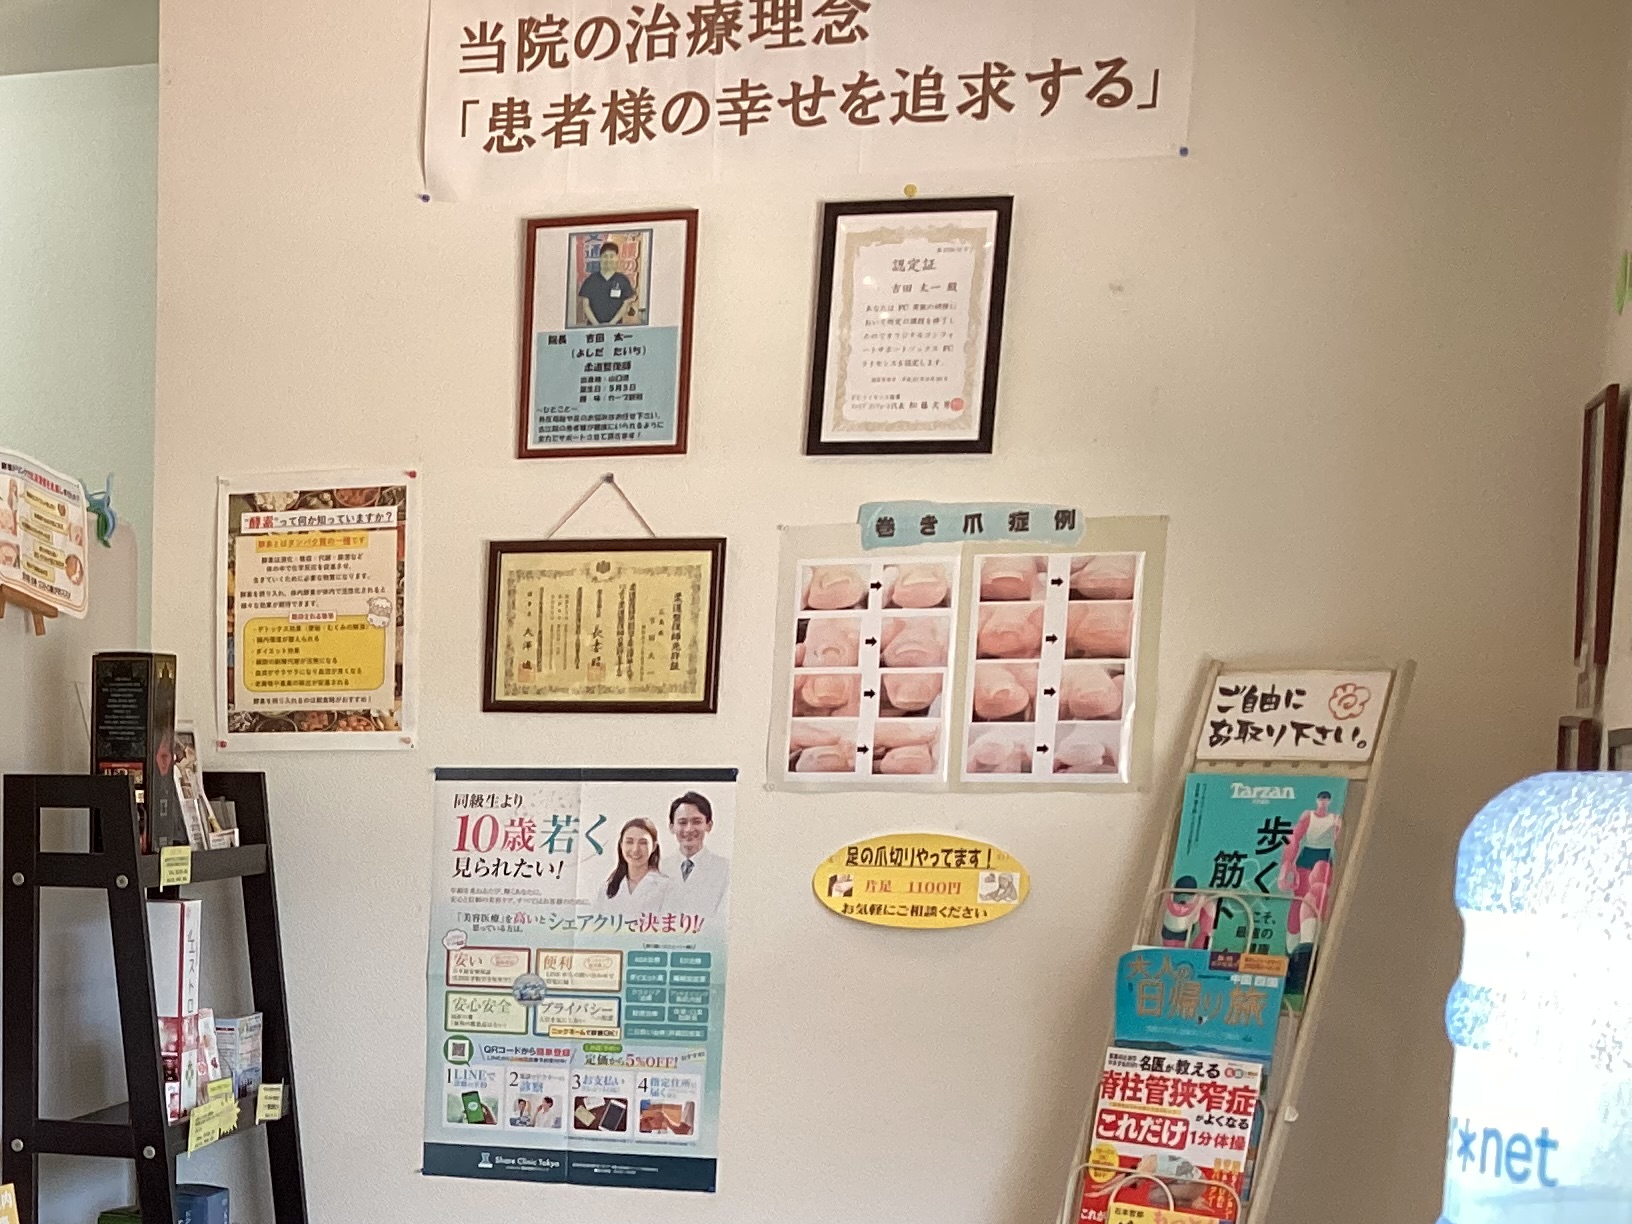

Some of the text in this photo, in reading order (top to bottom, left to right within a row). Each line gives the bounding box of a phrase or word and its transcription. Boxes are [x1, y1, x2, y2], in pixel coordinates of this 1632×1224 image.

[457, 0, 872, 75] 当院の治療理念
[458, 56, 1165, 156] 「患者様の幸せを追求する」
[892, 258, 936, 272] 認定証
[875, 509, 1077, 538] 巻き爪症例
[1217, 684, 1307, 714] ご自由に
[453, 793, 523, 809] 同級生より
[1231, 782, 1296, 800] Tarzan
[452, 813, 608, 856] 10歳若く
[846, 846, 991, 868] 足の爪切りやってます!
[1254, 816, 1294, 896] 歩く
[452, 857, 564, 880] 見られたい!
[865, 880, 961, 895] 片足 1100円
[842, 903, 988, 918] お気軽にご相談ください
[1204, 850, 1249, 950] 筋ト
[454, 952, 483, 968] 安い
[543, 955, 573, 971] 便利
[1127, 955, 1194, 979] 大人の
[452, 999, 512, 1014] 安心安全
[541, 1002, 613, 1015] プライバシー
[1136, 978, 1269, 1027] 日帰り旅
[447, 1069, 453, 1083] 1
[1139, 1055, 1220, 1079] 名医が教える
[509, 1071, 519, 1087] 2
[571, 1074, 581, 1090] 3
[638, 1077, 648, 1092] 4
[1101, 1070, 1257, 1116] 脊柱管狭窄症
[1098, 1111, 1187, 1148] これだけ
[1196, 1114, 1249, 1130] がよくなる
[1189, 1130, 1246, 1151] 1分体操
